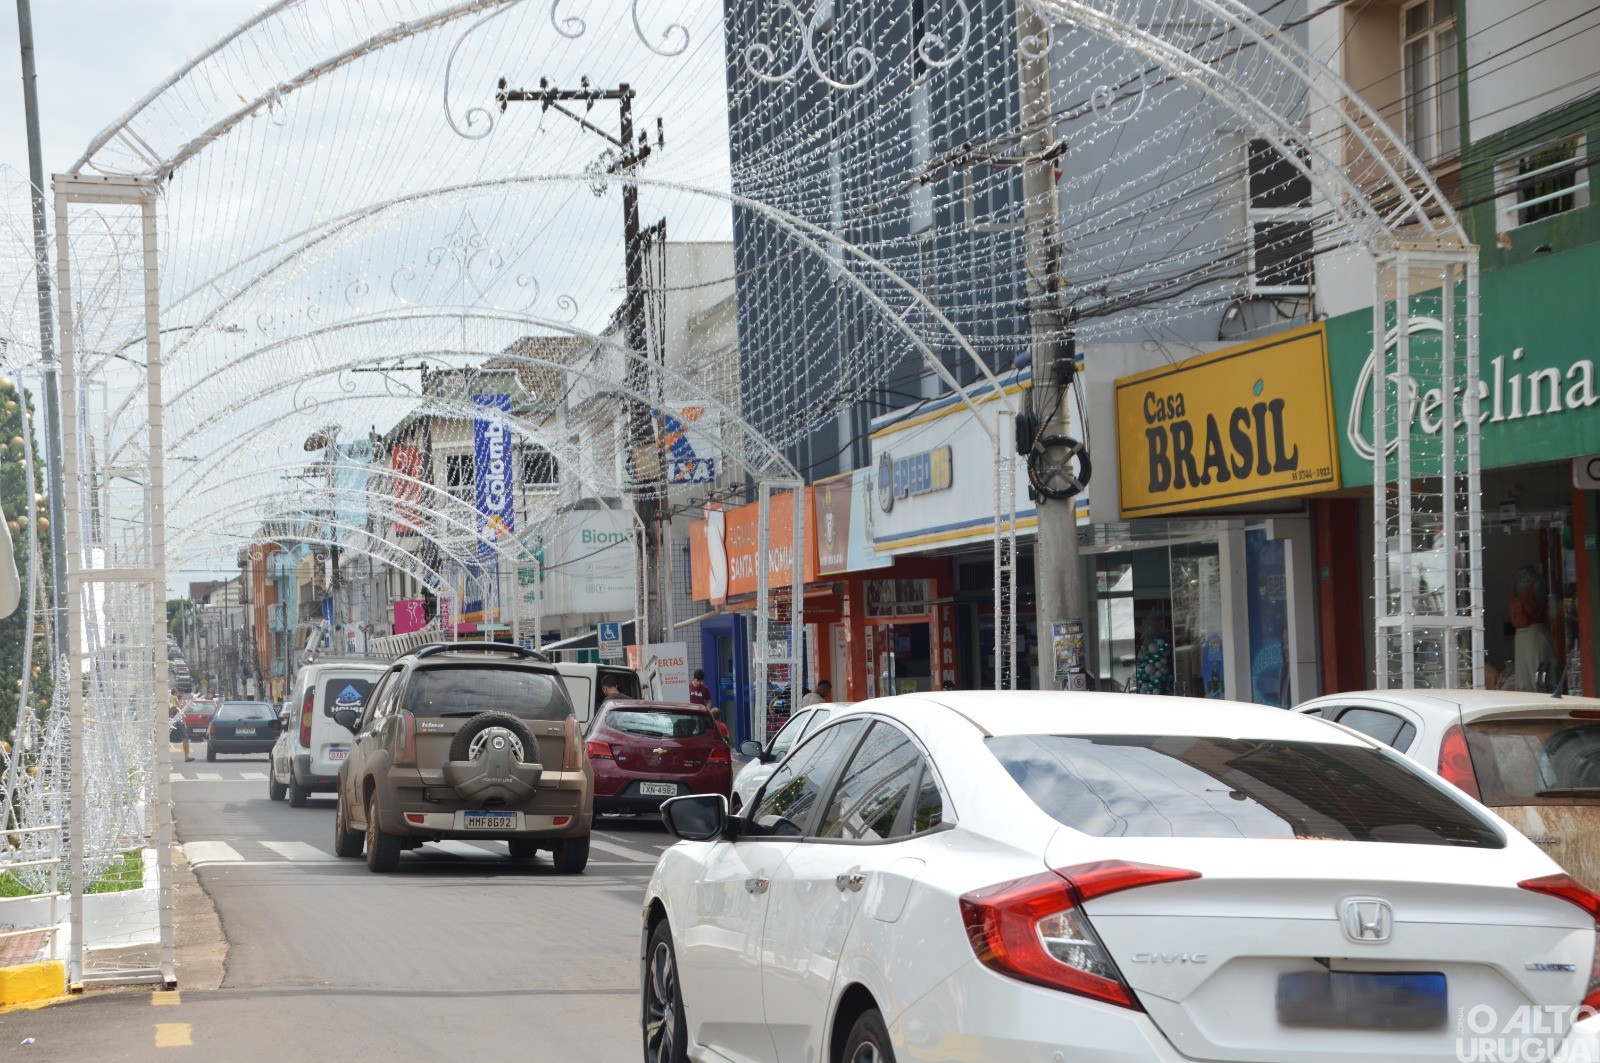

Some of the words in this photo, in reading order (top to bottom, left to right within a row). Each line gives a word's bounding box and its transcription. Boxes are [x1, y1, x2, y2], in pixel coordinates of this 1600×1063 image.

[1144, 391, 1186, 424] Casa
[1145, 397, 1299, 493] BRASIL
[730, 553, 754, 581] SANTA
[658, 658, 684, 667] ERTAS
[1130, 952, 1209, 964] CIVIC
